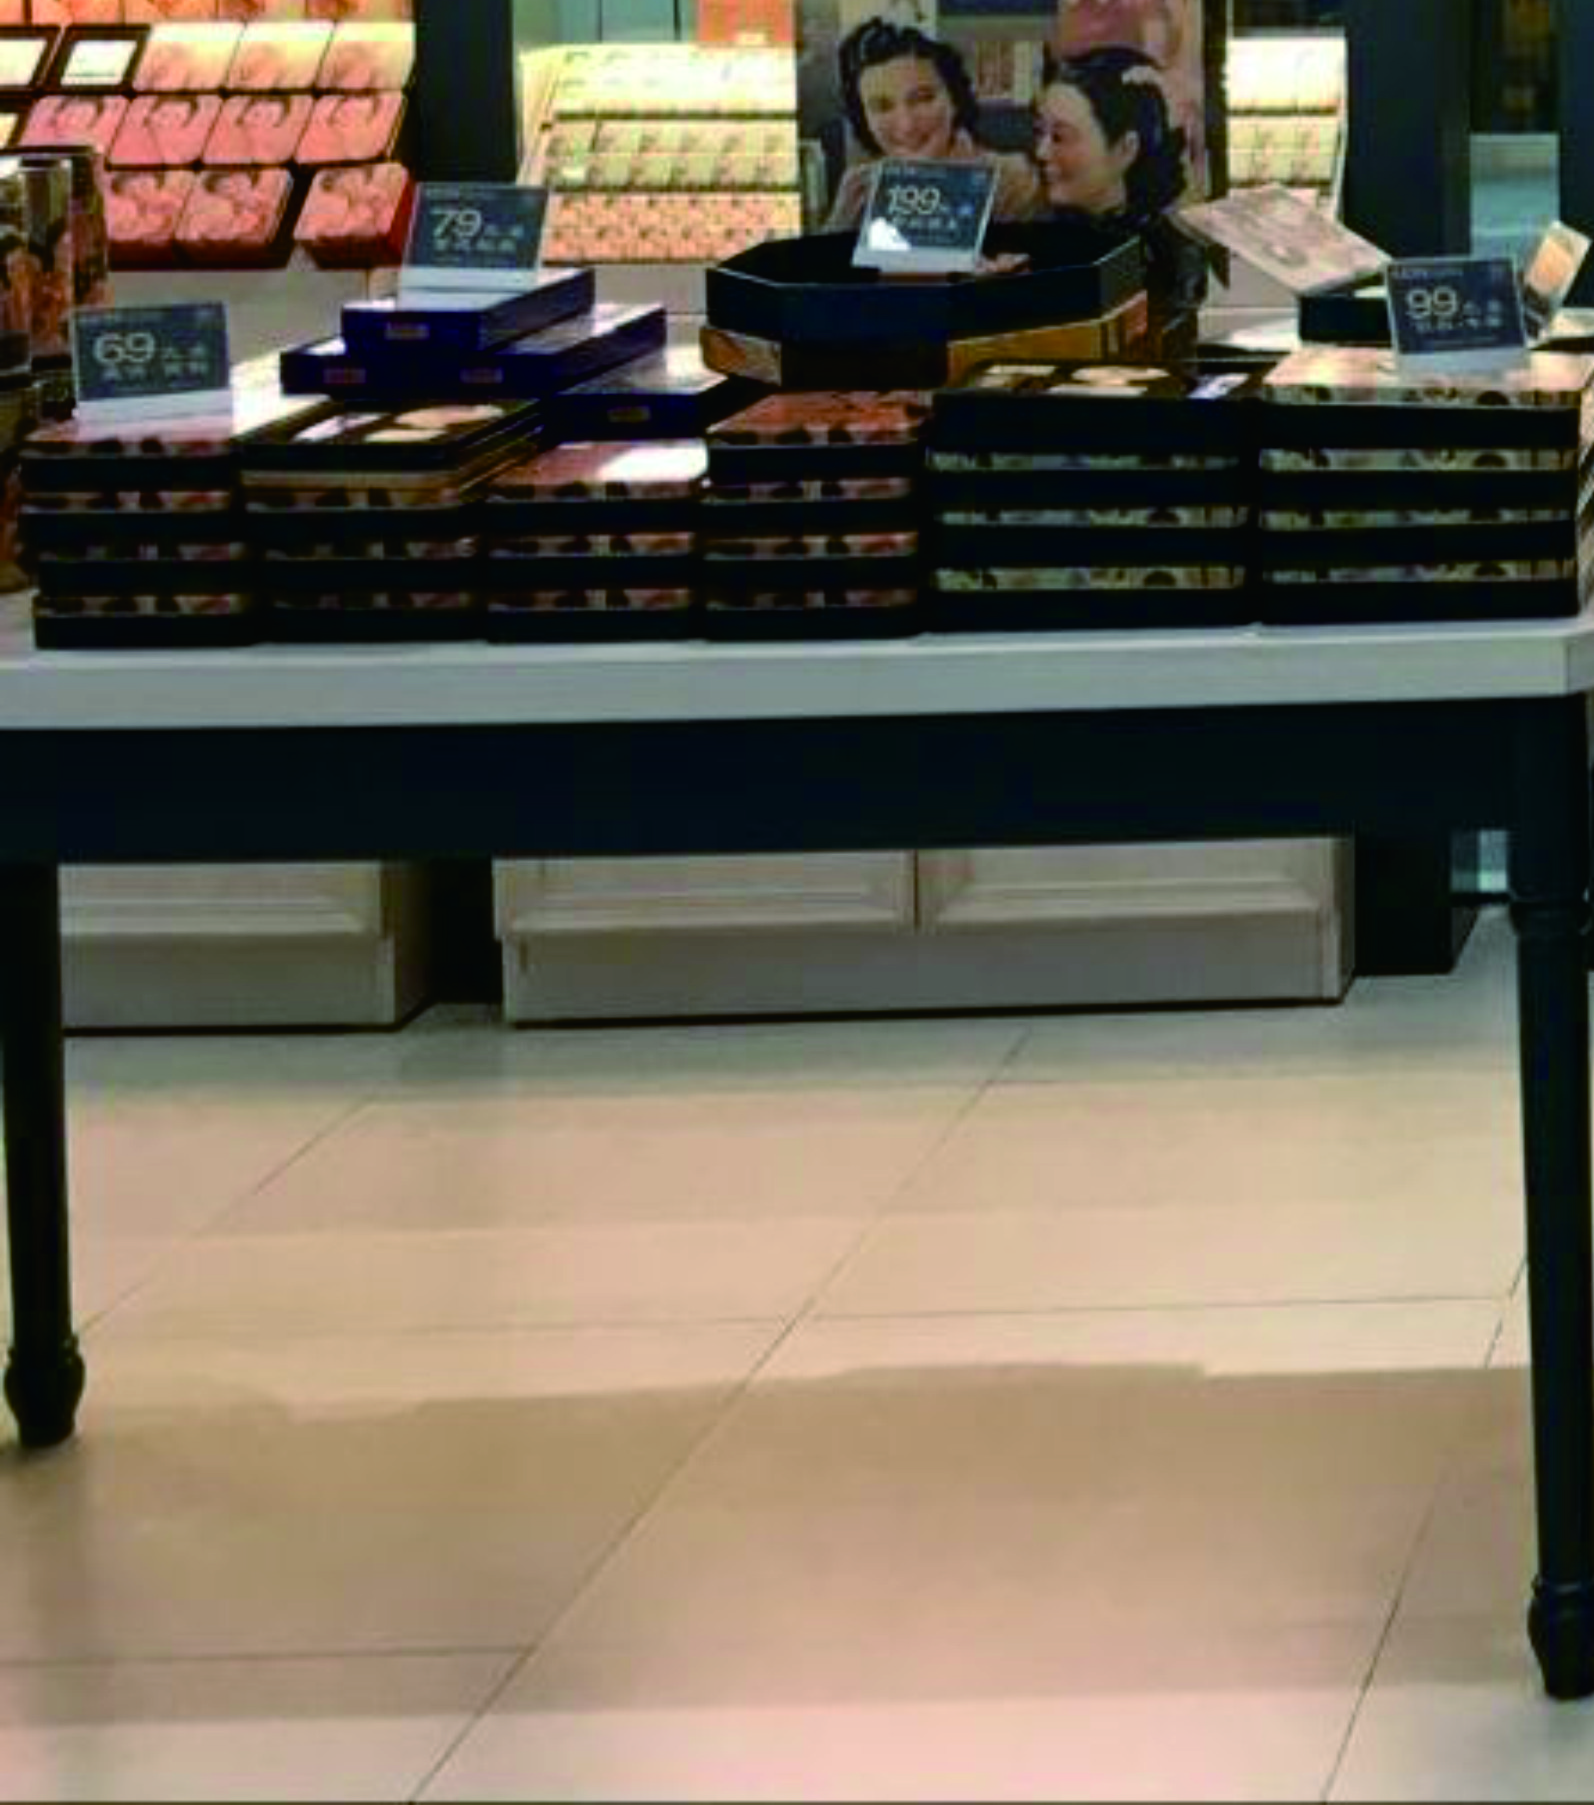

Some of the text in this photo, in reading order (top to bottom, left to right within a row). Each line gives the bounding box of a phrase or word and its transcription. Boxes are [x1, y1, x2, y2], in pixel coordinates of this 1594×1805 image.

[887, 185, 941, 215] 199
[430, 208, 483, 237] 79
[1405, 287, 1458, 320] 99
[93, 332, 155, 364] 69
